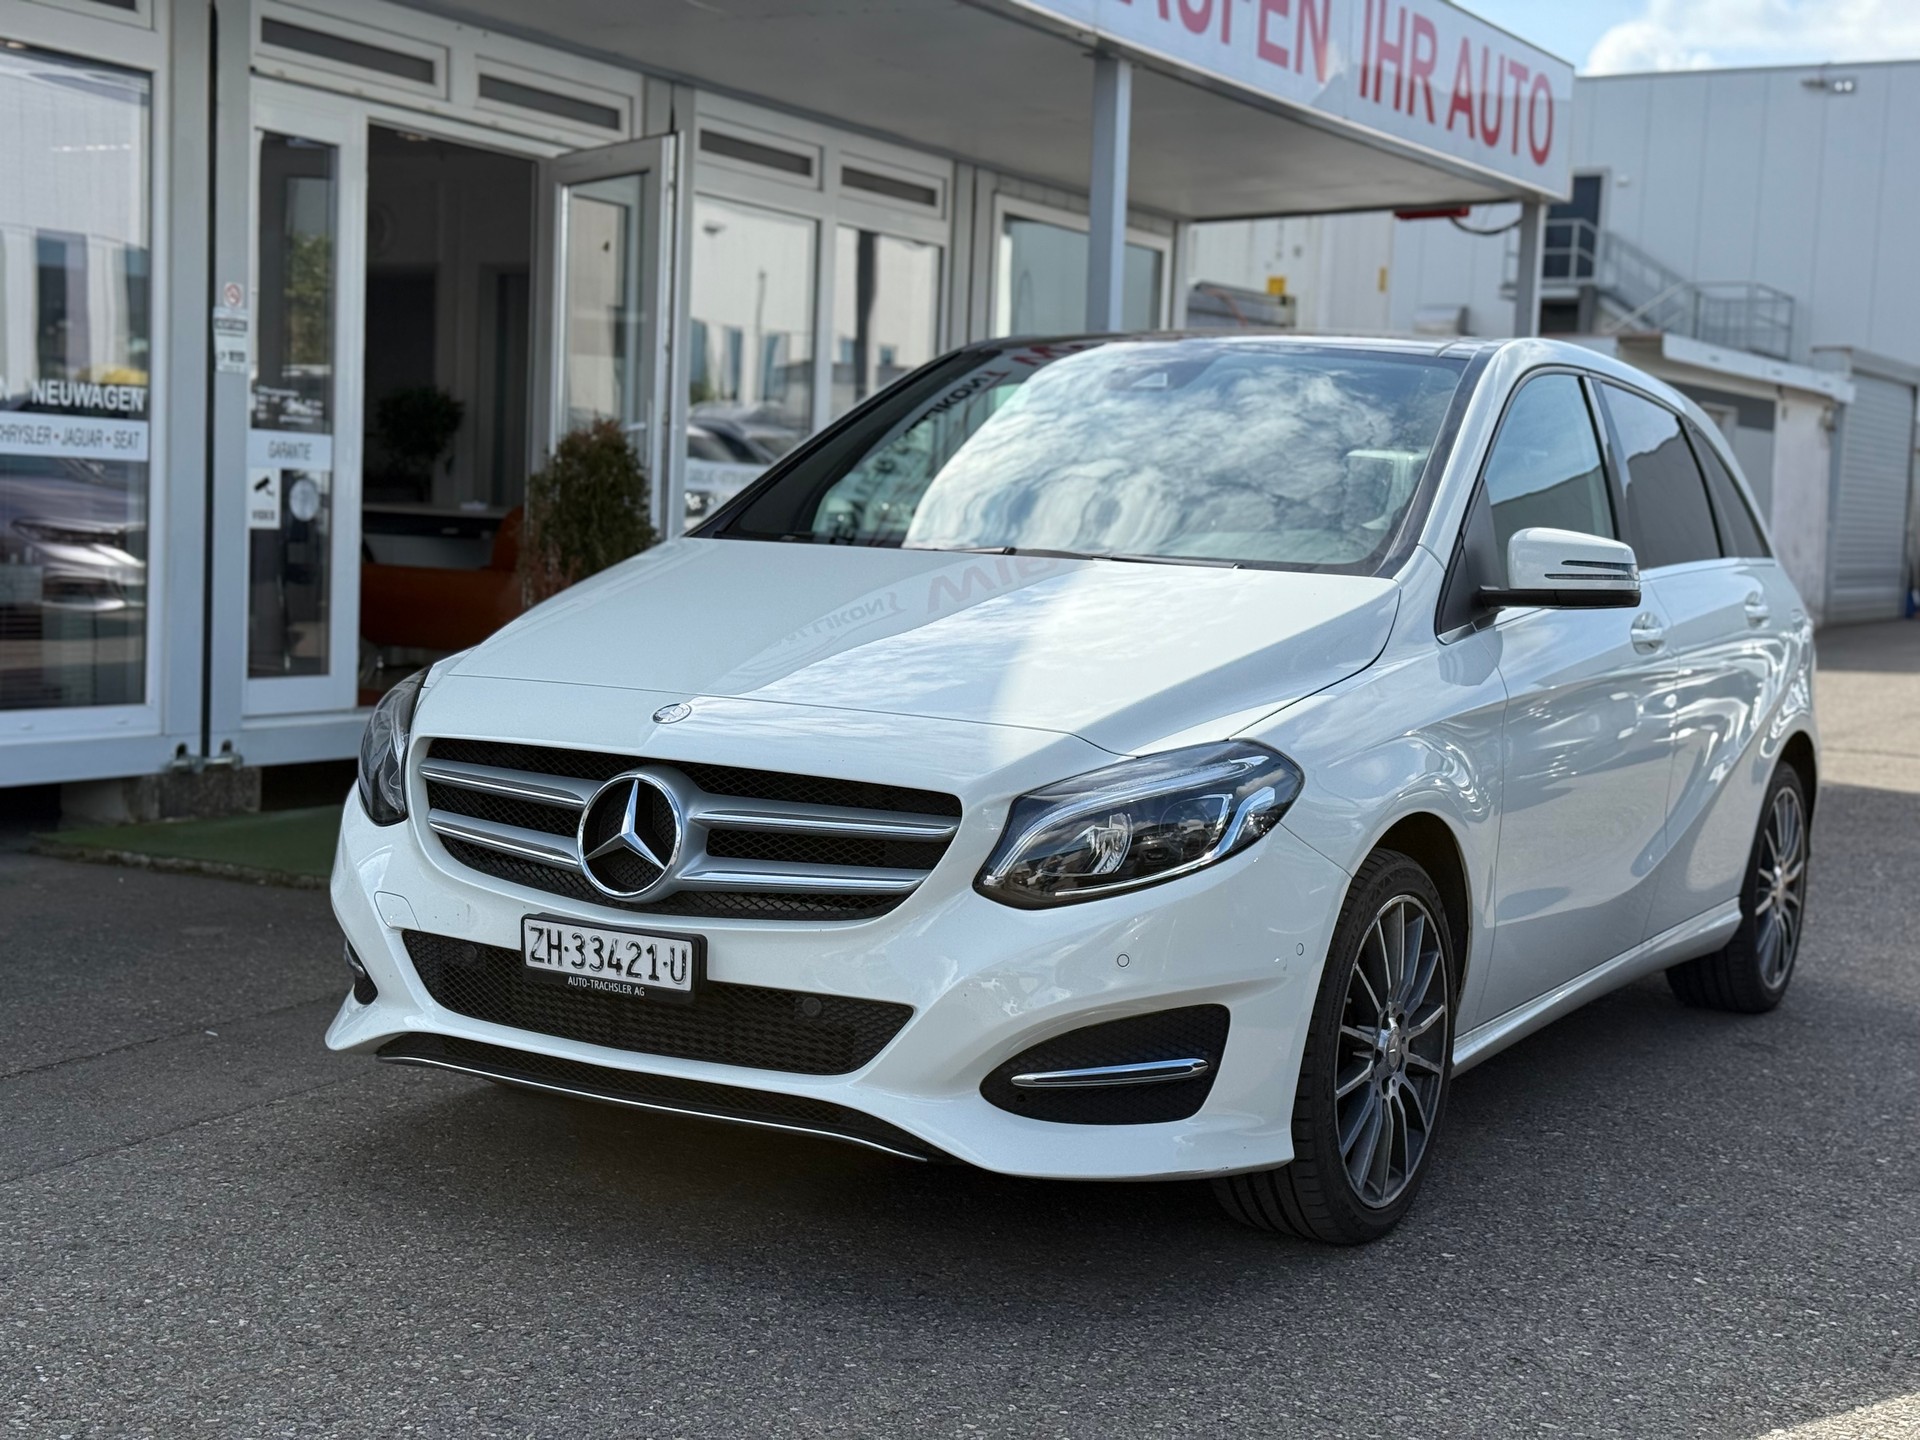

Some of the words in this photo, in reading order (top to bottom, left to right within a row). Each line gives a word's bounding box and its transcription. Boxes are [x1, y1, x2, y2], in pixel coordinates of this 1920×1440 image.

[1359, 0, 1437, 125] IHR
[1445, 36, 1554, 167] AUTO
[31, 378, 145, 412] NEUWAGEN
[60, 426, 104, 449] JAGUAR
[112, 429, 141, 450] SEAT
[268, 440, 312, 461] GARANTIE
[567, 976, 632, 995] AUTO-TRACHSLER
[634, 985, 645, 997] AG
